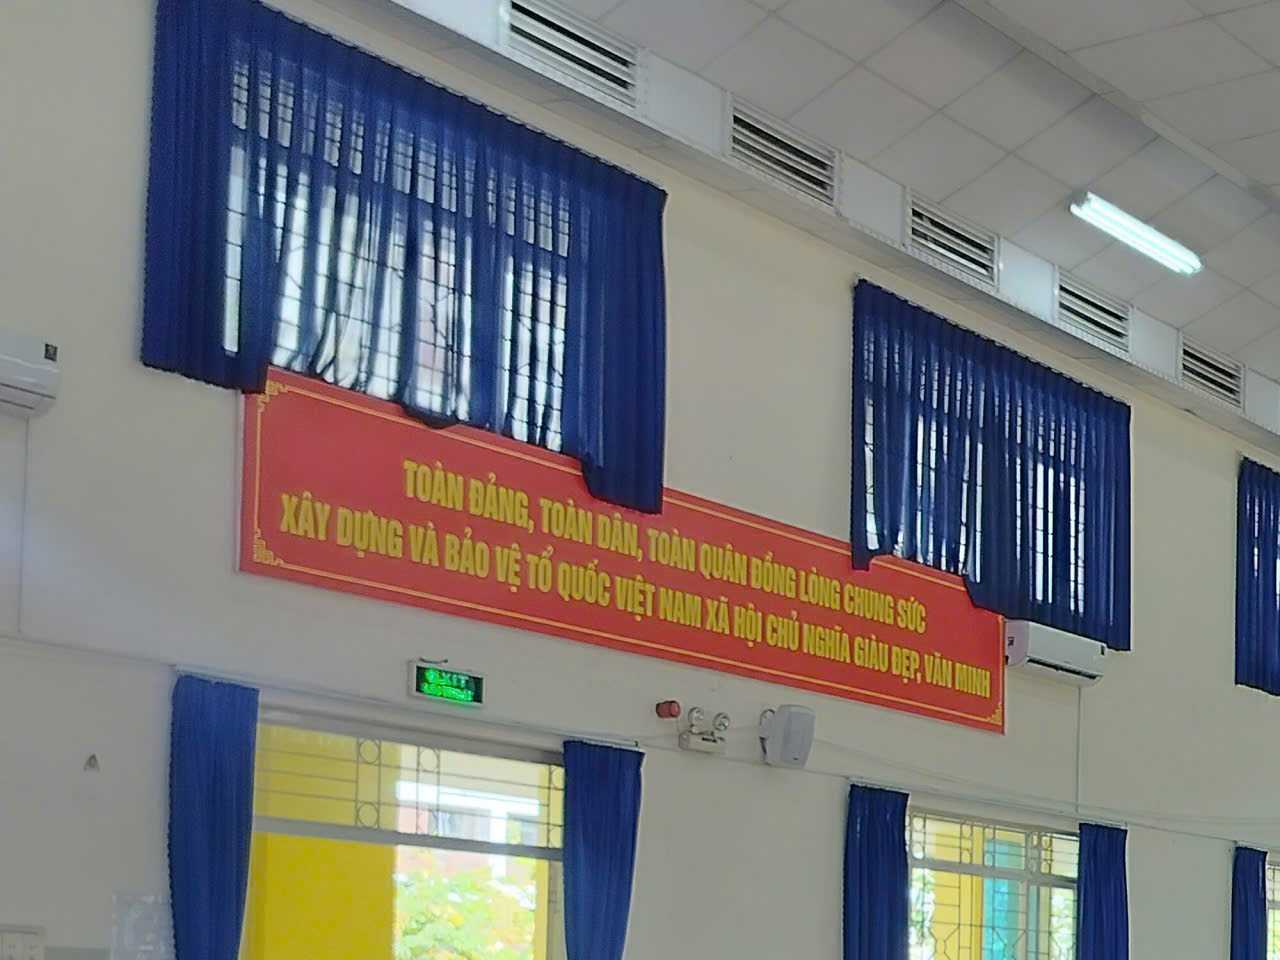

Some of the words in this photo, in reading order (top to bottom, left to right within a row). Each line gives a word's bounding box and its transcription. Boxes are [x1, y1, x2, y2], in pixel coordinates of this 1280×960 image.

[280, 491, 331, 541] XÂY
[336, 507, 404, 559] DỰNG
[408, 521, 440, 567] VÀ
[444, 526, 490, 579] BẢO
[495, 543, 522, 593] VỆ
[526, 544, 554, 593] TỔ
[557, 559, 611, 607] QUỐC
[614, 574, 655, 621] VIỆT
[658, 586, 702, 627] NAM
[705, 596, 730, 635] XÃ
[733, 604, 762, 648] HỘI
[765, 609, 800, 652] CHỦ
[802, 624, 852, 665] NGHĨA
[853, 634, 889, 673] GIÀU
[890, 646, 922, 685] ĐẸP,
[923, 651, 953, 689] VĂN
[954, 661, 991, 698] MINH
[403, 459, 463, 511] TOÀN
[468, 472, 534, 534] ĐẢNG,
[540, 497, 593, 545] TOÀN
[597, 512, 643, 562] DÂN,
[647, 527, 696, 572] TOÀN
[700, 543, 747, 586] QUÂN
[799, 570, 841, 612] LÒNG
[843, 583, 895, 625] CHUNG
[896, 595, 927, 634] SỨC
